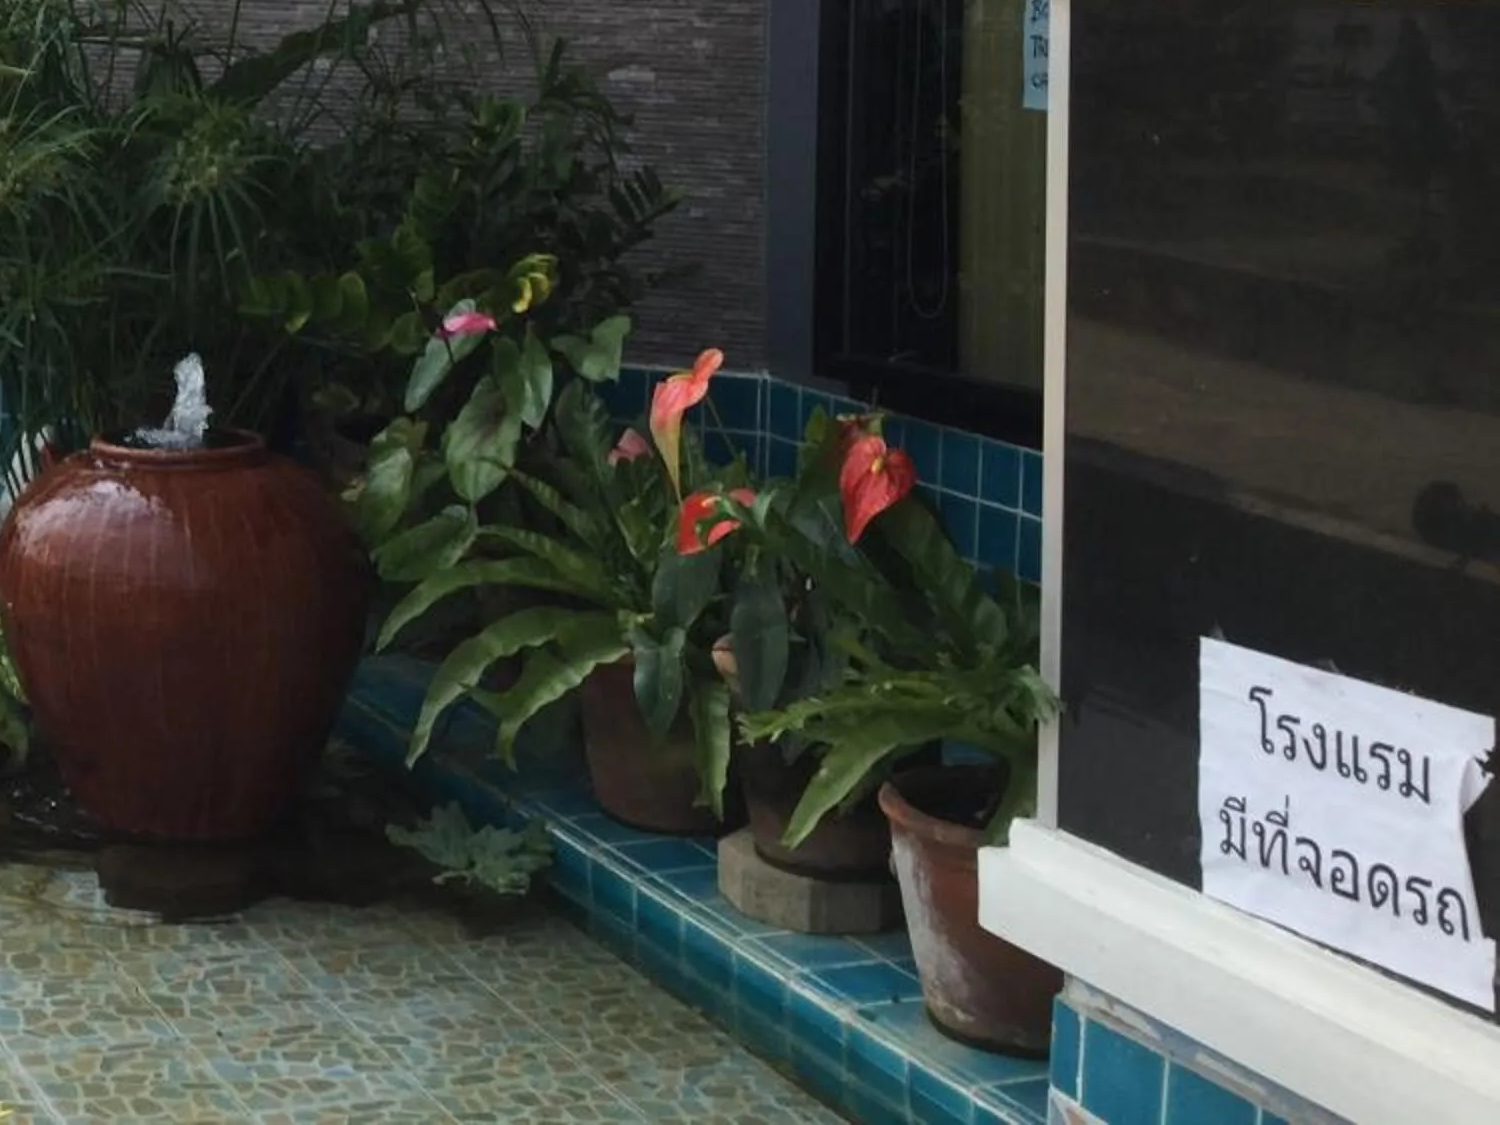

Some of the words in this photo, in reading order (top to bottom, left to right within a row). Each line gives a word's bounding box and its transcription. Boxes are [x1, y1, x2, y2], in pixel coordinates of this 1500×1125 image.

[1248, 685, 1432, 805] โรงแรม
[1218, 794, 1471, 943] มีที่จอดรถ
